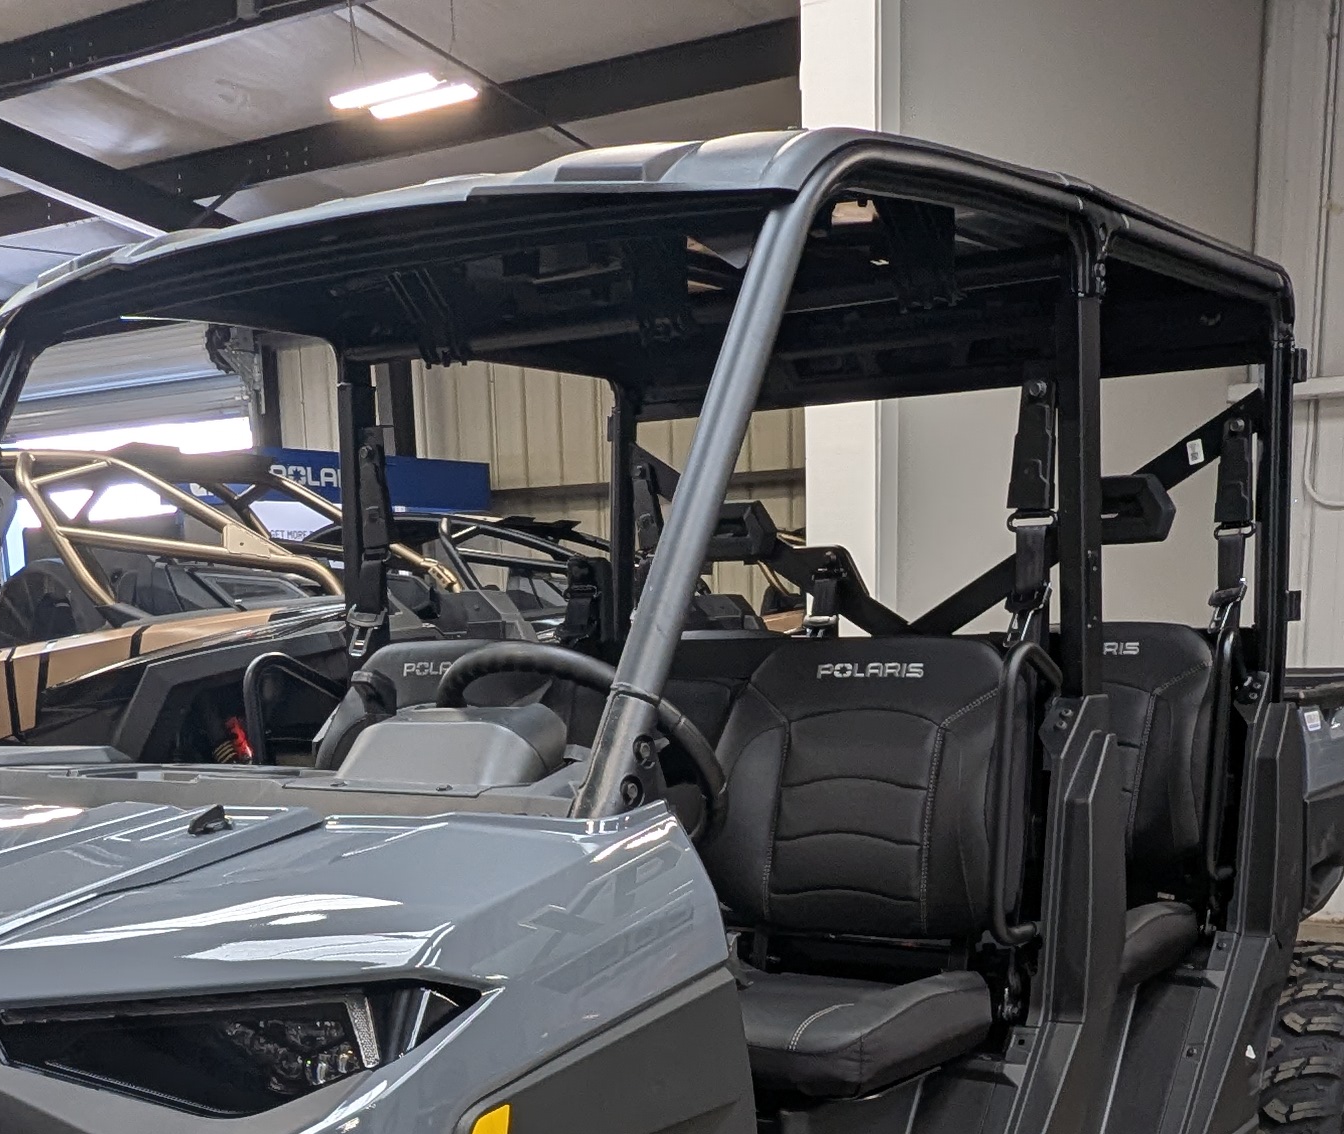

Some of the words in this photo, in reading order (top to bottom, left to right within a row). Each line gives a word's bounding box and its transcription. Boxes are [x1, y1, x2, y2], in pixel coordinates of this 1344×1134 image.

[268, 464, 342, 487] POLA
[1103, 641, 1140, 655] RIS
[816, 662, 925, 679] POLARIS
